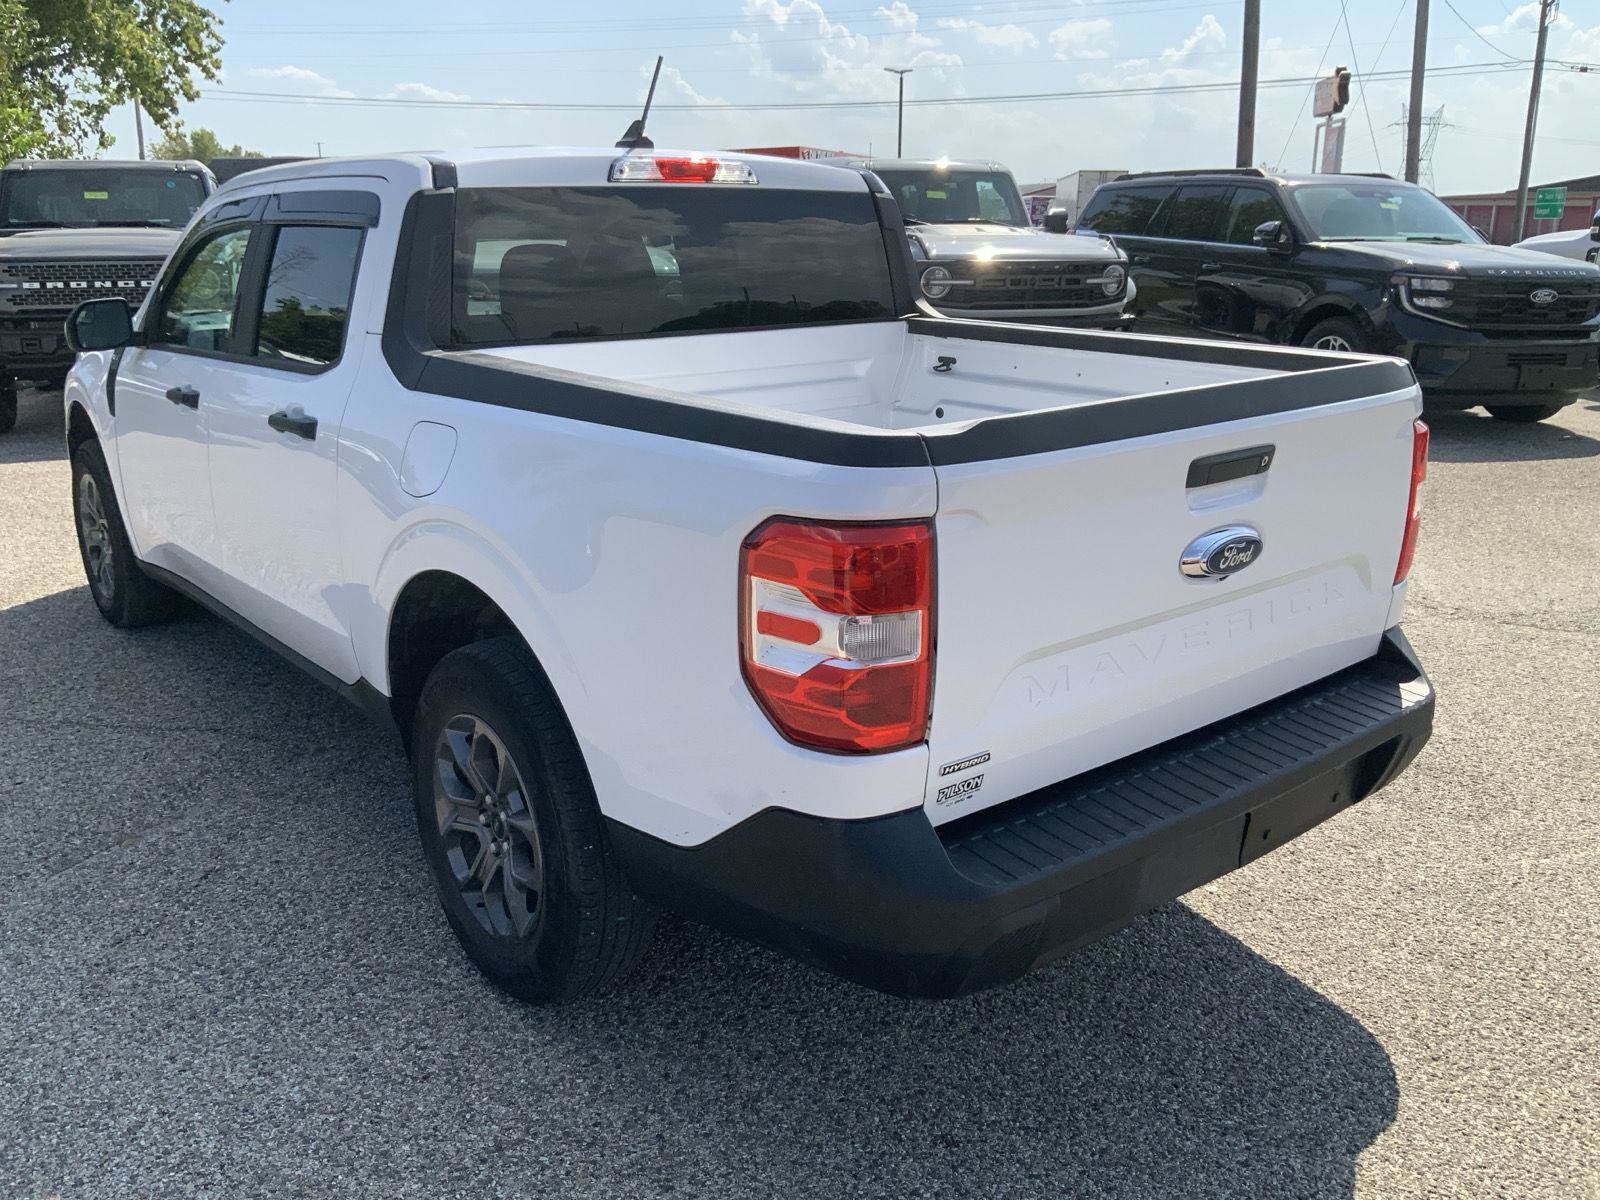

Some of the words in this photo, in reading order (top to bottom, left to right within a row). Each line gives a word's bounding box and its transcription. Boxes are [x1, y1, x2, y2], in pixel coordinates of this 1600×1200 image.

[22, 280, 155, 289] BRONCO
[1219, 542, 1254, 570] Ford
[1022, 582, 1347, 708] MAVERICK
[944, 754, 989, 775] HYBRID
[937, 774, 984, 803] PILSON
